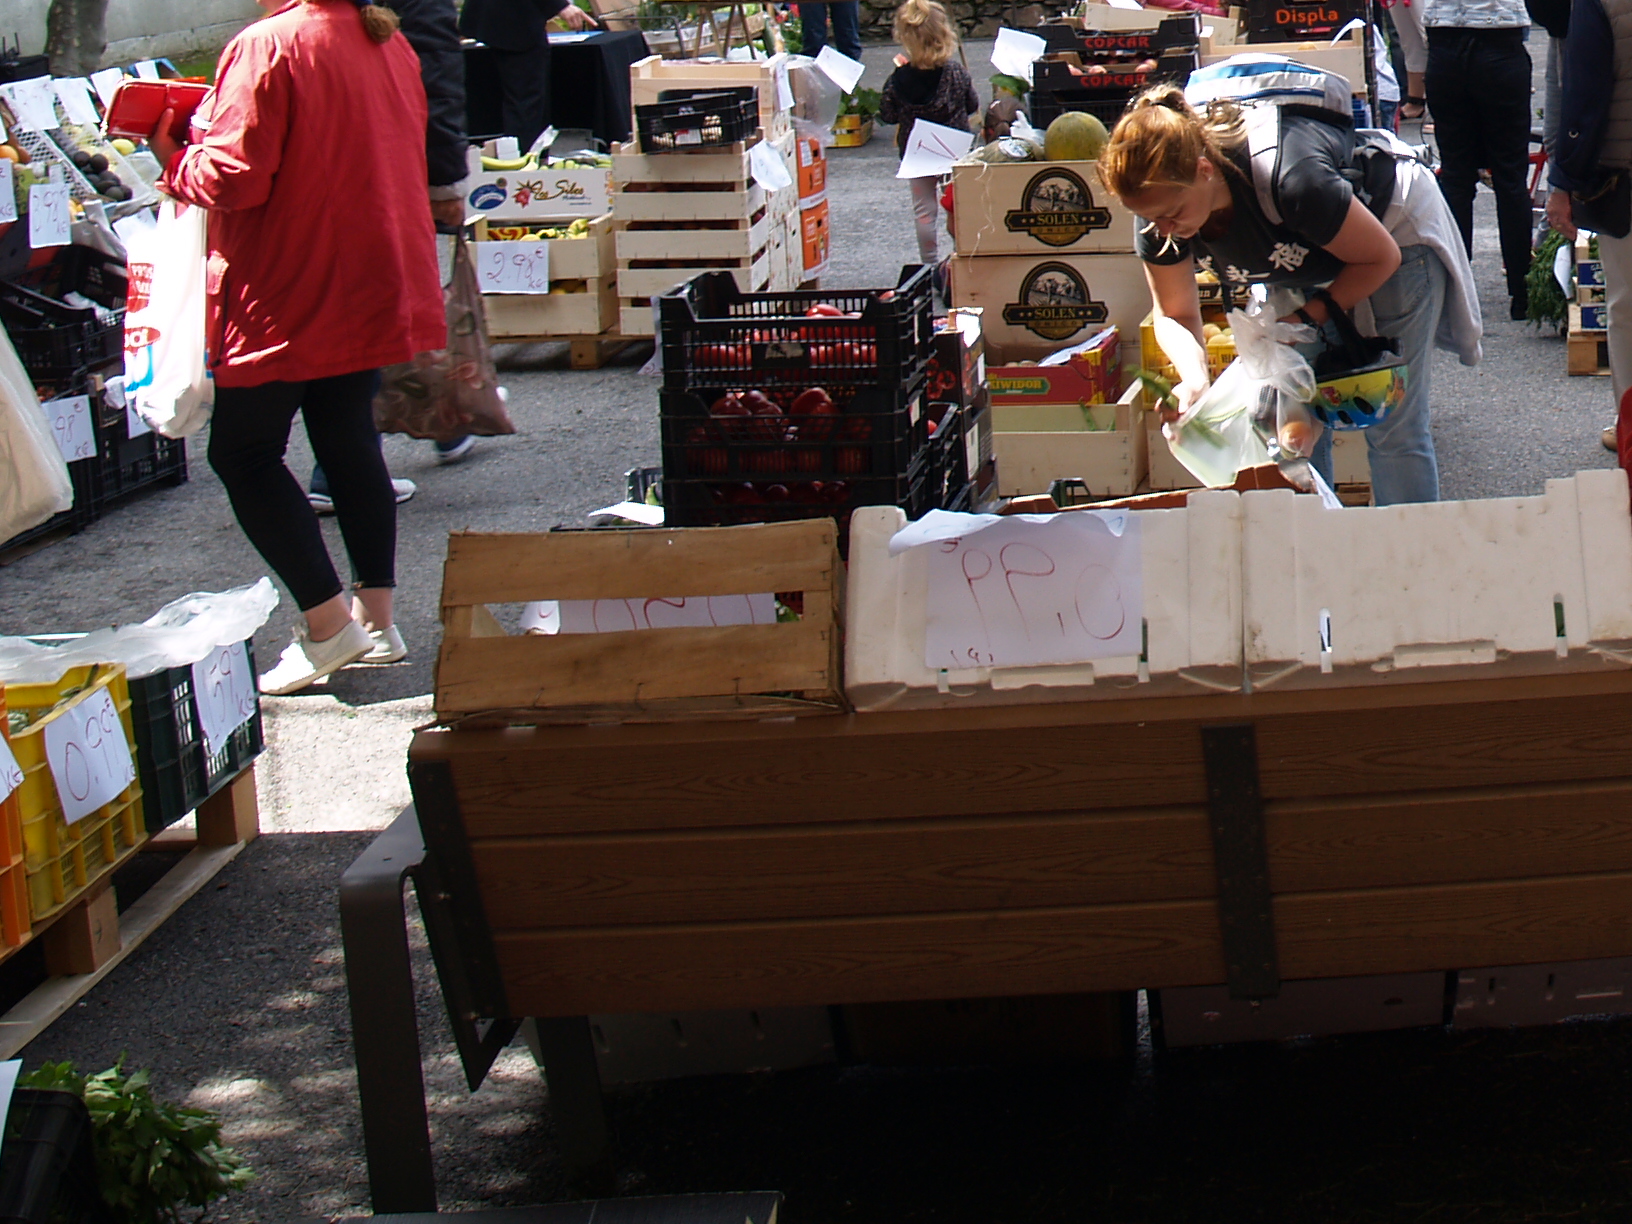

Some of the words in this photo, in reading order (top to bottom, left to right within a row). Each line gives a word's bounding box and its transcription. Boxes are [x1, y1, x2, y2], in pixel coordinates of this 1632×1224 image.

[1275, 7, 1339, 26] Displa
[1084, 37, 1150, 49] COPCAR
[1036, 214, 1080, 226] SOLEN
[1033, 308, 1076, 320] SOLEN
